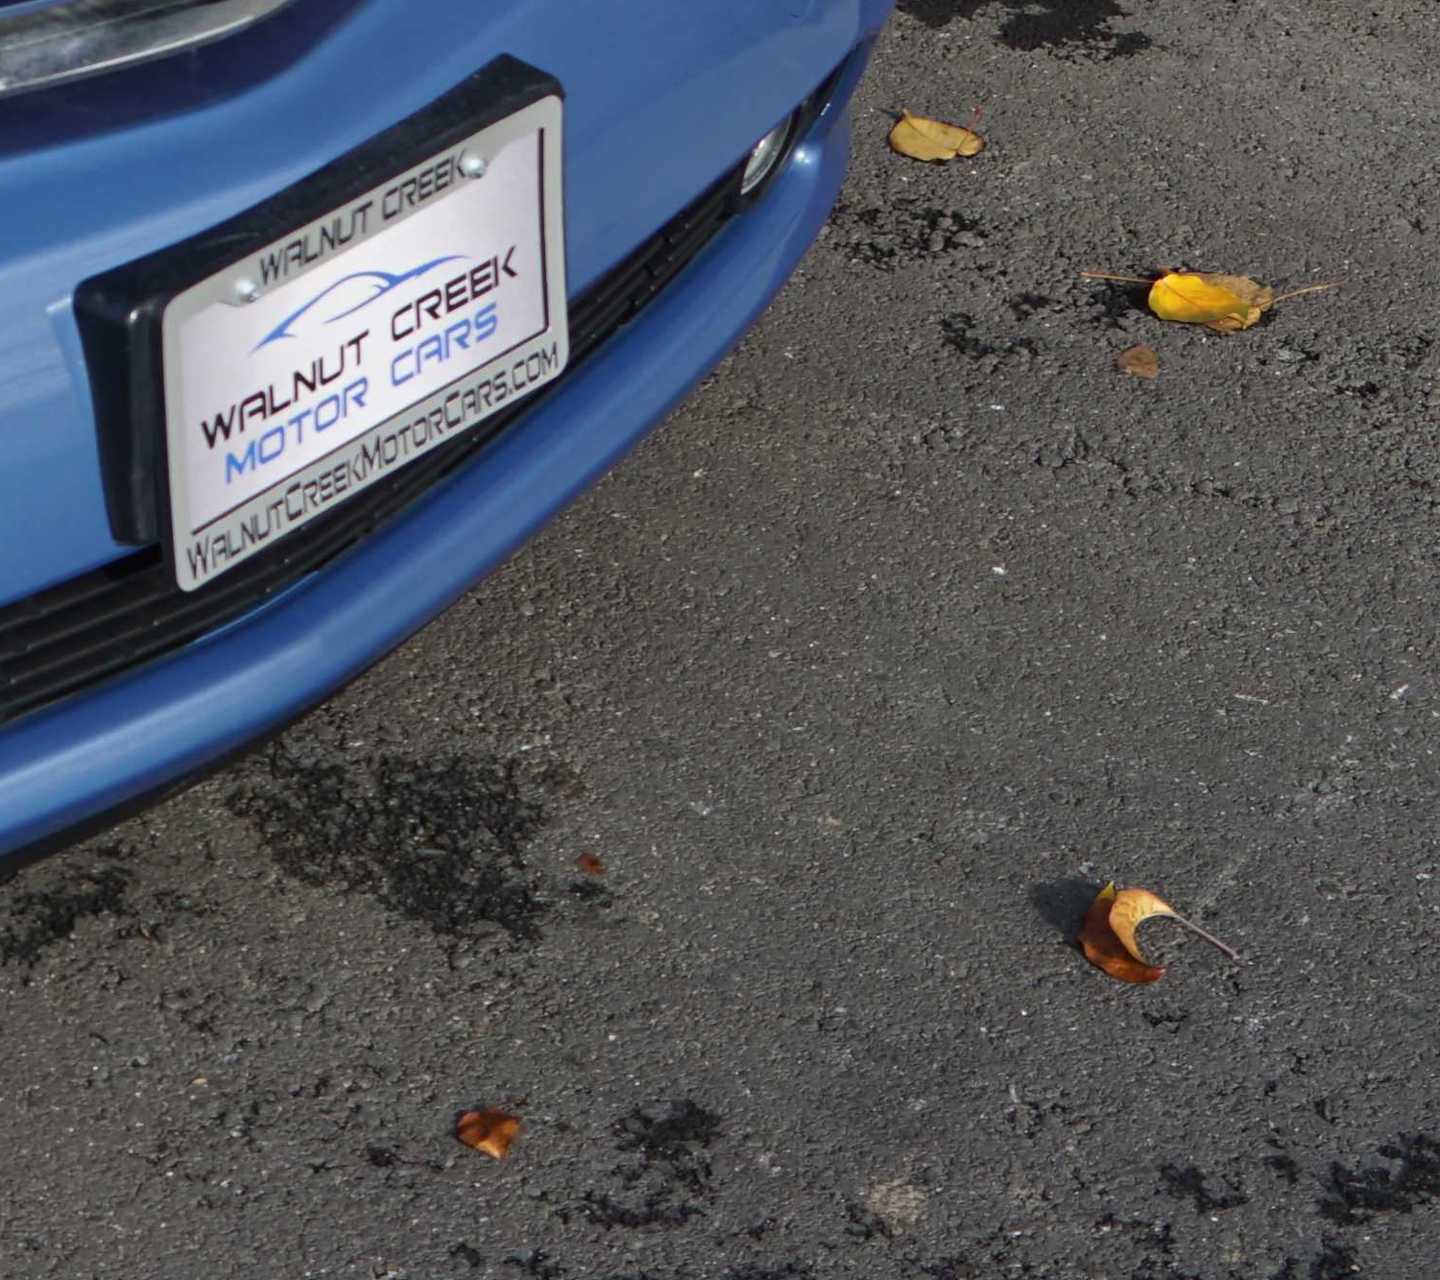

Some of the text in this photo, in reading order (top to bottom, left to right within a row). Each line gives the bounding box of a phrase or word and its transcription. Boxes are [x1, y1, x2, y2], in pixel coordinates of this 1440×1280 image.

[259, 149, 470, 286] WALNUT CREEK
[200, 244, 520, 450] WALNUT CREEK
[224, 301, 499, 485] MOTOR CARS
